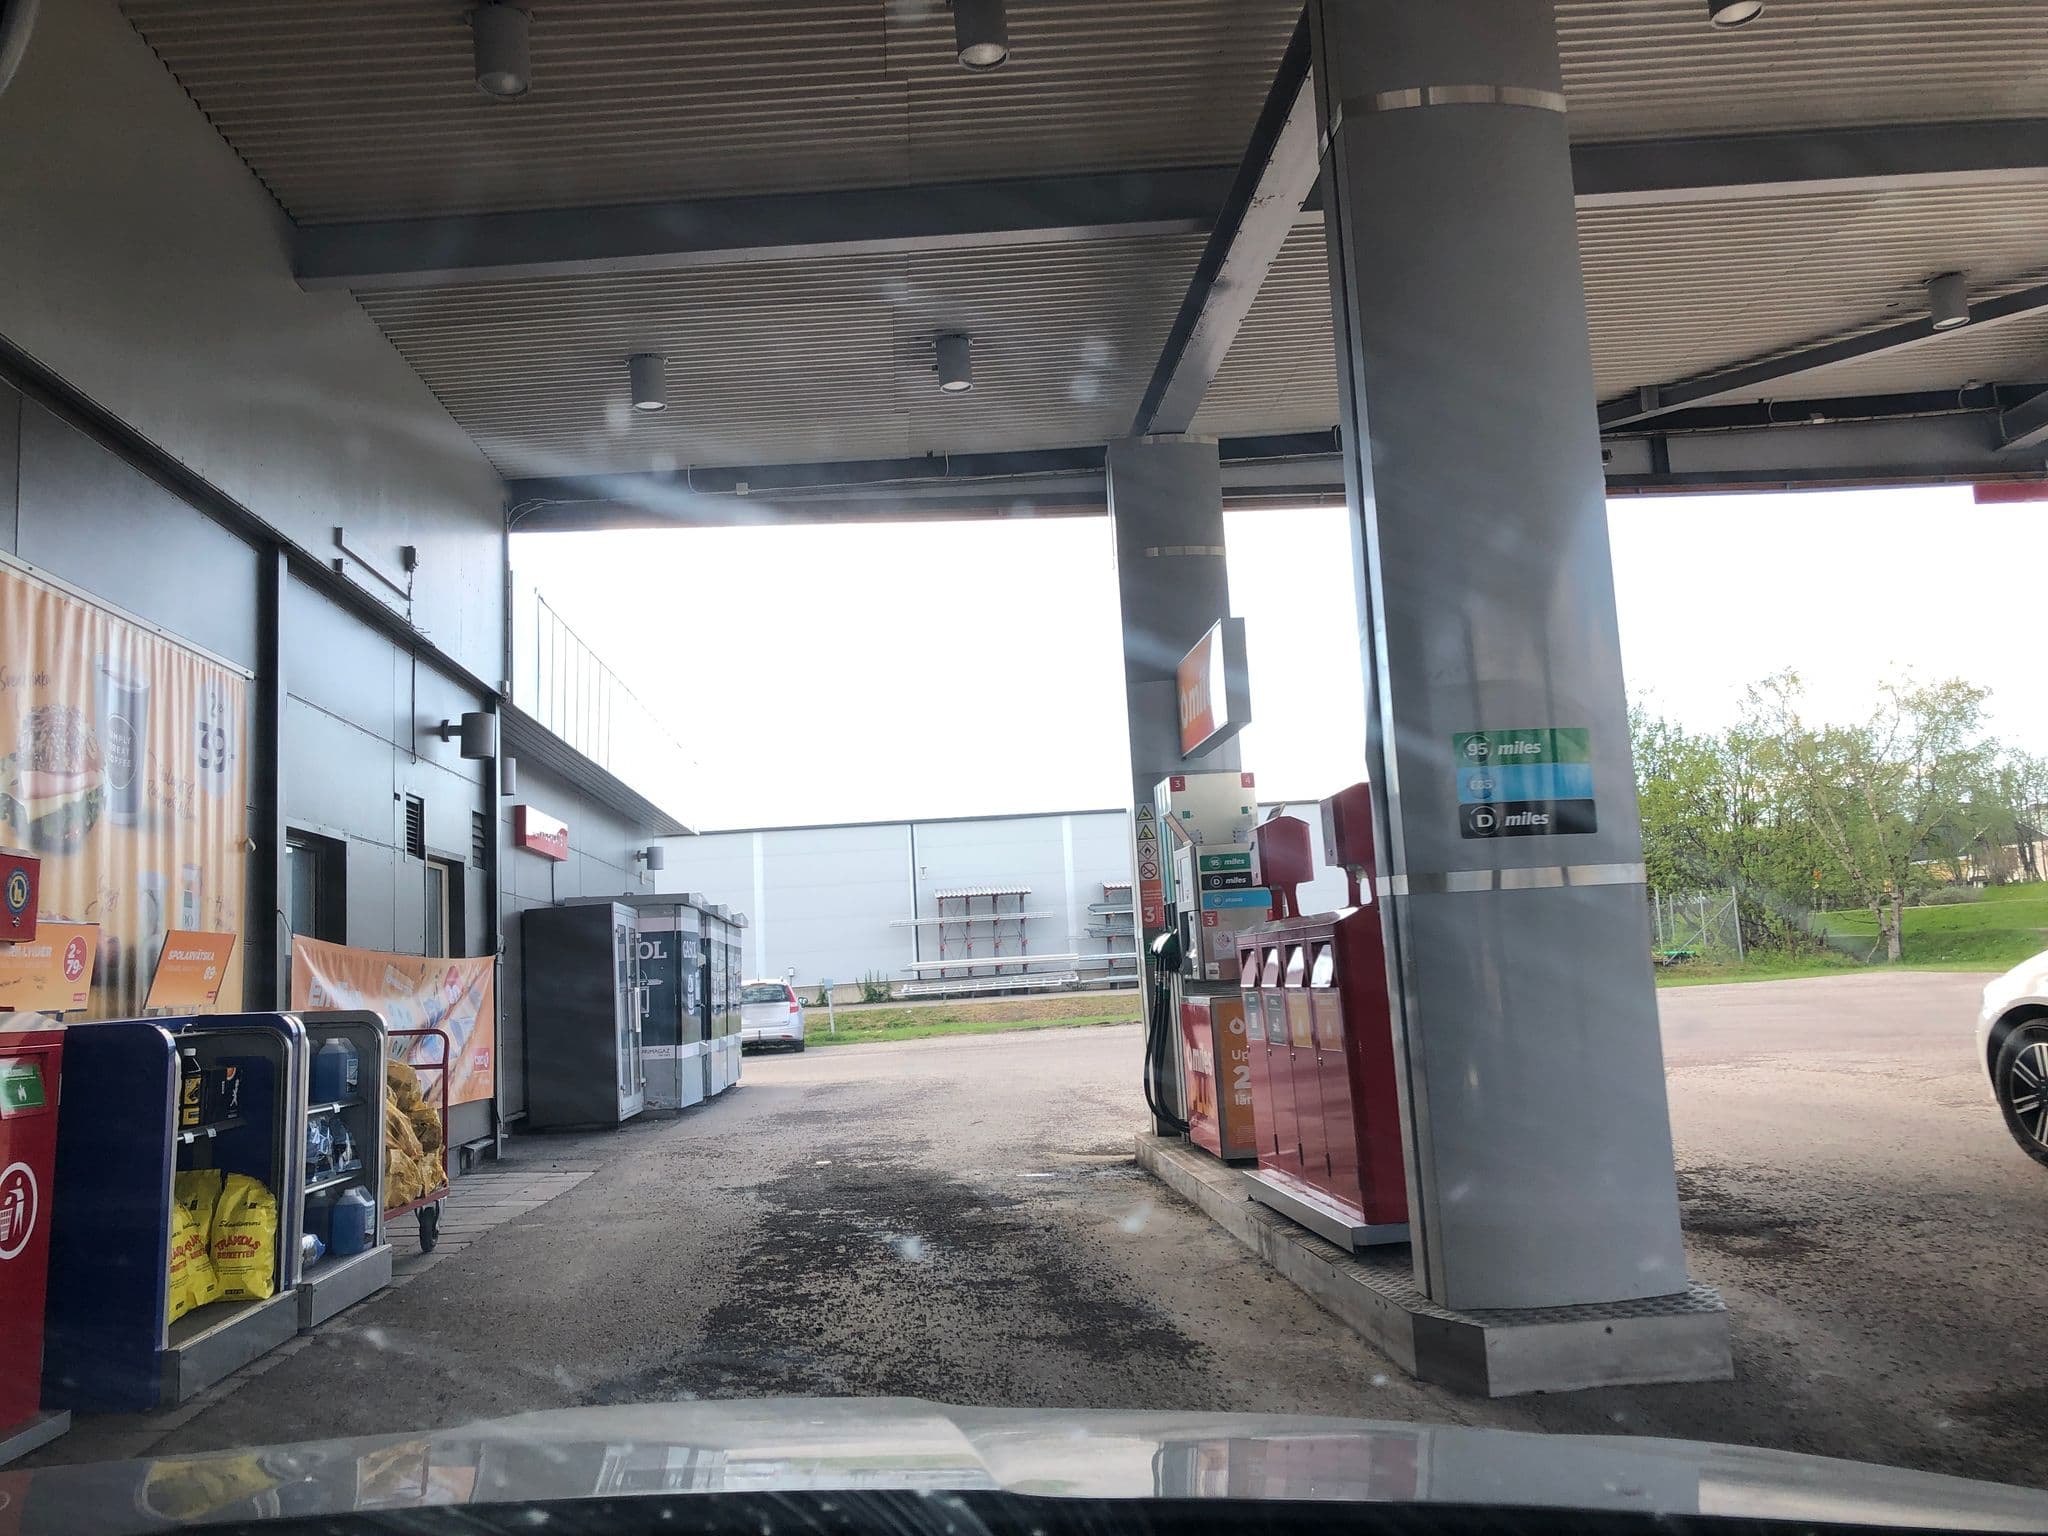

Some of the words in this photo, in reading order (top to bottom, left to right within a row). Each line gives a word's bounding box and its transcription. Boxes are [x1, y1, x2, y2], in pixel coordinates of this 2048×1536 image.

[1467, 742, 1488, 756] 95
[1497, 740, 1542, 755] miles
[1476, 814, 1494, 828] D
[1504, 811, 1550, 826] miles
[1224, 857, 1245, 866] miles
[1225, 876, 1247, 885] miles
[1144, 906, 1155, 923] 3
[1206, 916, 1214, 926] 3
